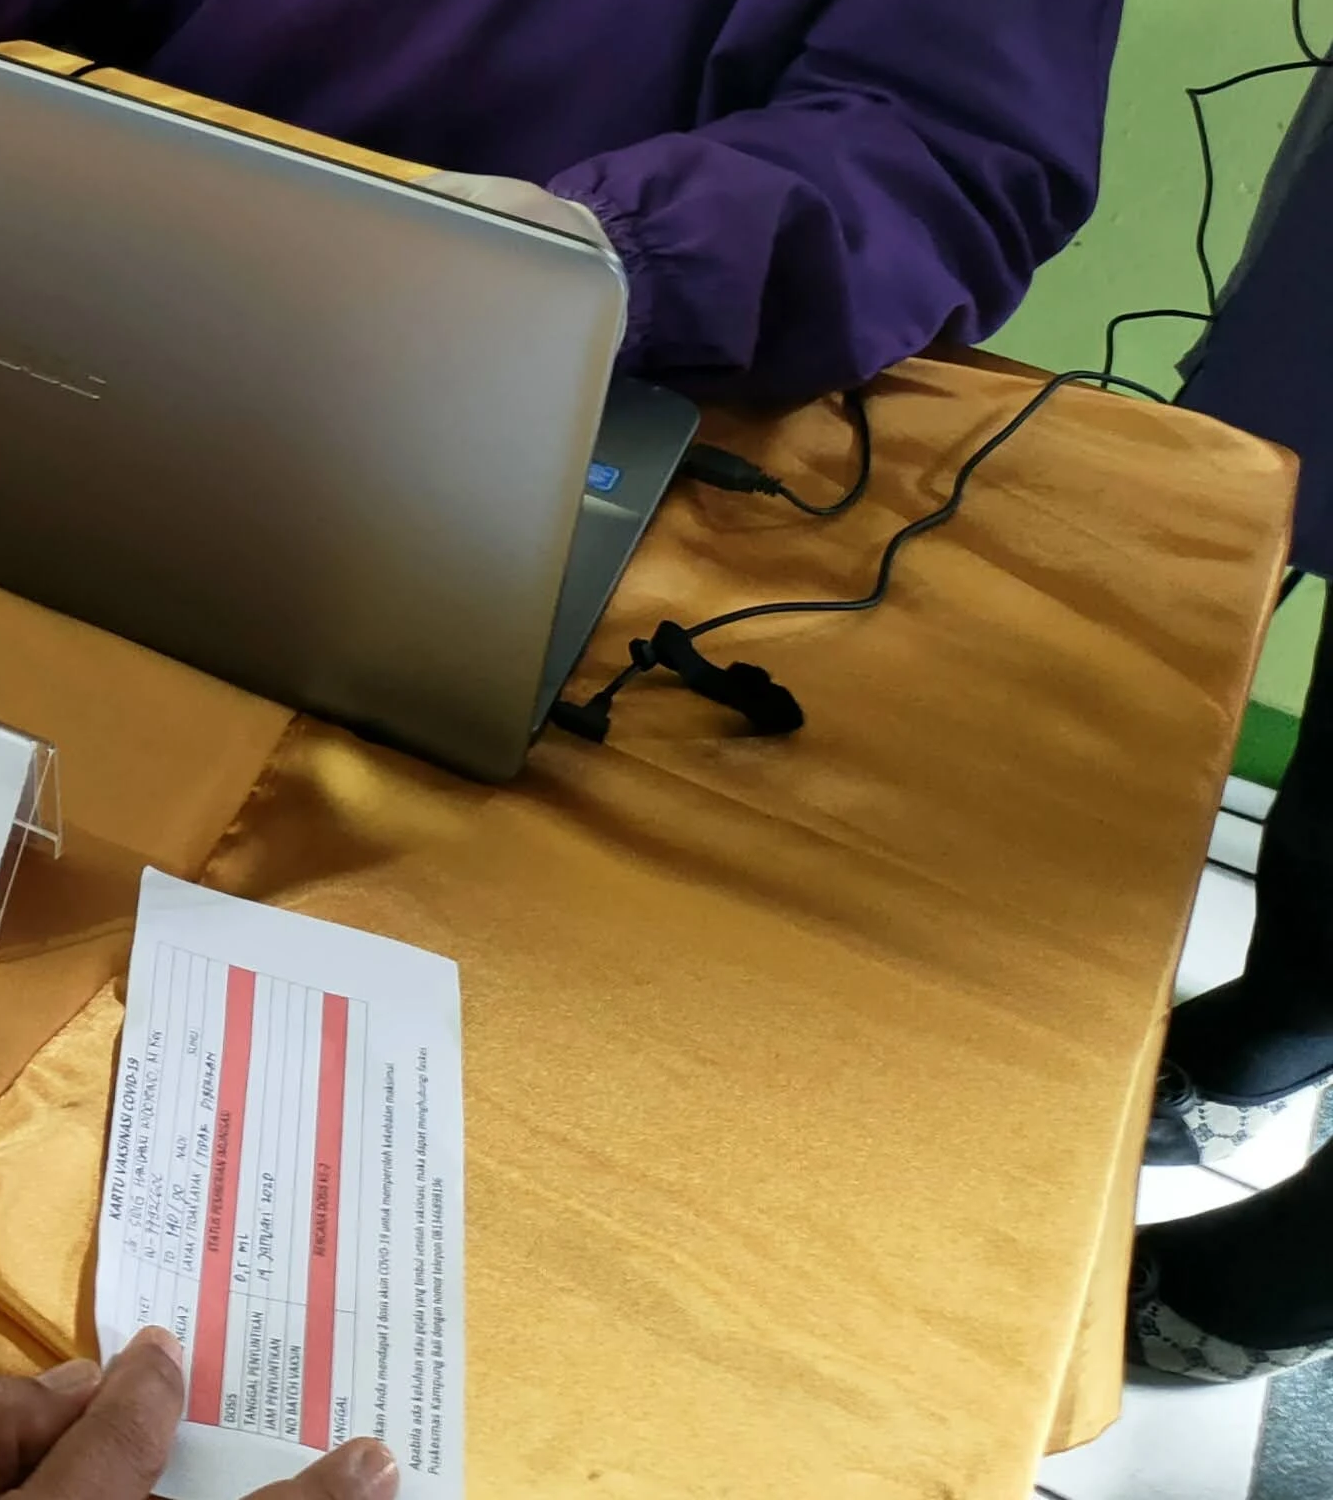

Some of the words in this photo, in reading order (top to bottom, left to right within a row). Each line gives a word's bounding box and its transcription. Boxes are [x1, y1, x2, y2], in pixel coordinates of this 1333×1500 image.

[121, 1057, 139, 1112] COVID-19
[113, 1112, 133, 1174] VAKSINASI
[108, 1177, 125, 1220] KARTU
[246, 1310, 264, 1377] PENYUNTIKAN
[287, 1344, 301, 1380] VAKSIN
[375, 1332, 390, 1381] mendapat
[265, 1337, 282, 1406] PENYUNTIKAN
[430, 1359, 445, 1410] Kampung
[223, 1393, 238, 1423] DOSIS
[243, 1379, 259, 1426] TANGGAL
[263, 1408, 277, 1430] JAM
[285, 1381, 300, 1416] BATCH
[373, 1383, 388, 1412] Anda
[410, 1404, 423, 1425] ada
[284, 1417, 298, 1436] NO
[427, 1414, 441, 1475] Puskesmas
[408, 1428, 423, 1470] Apabila
